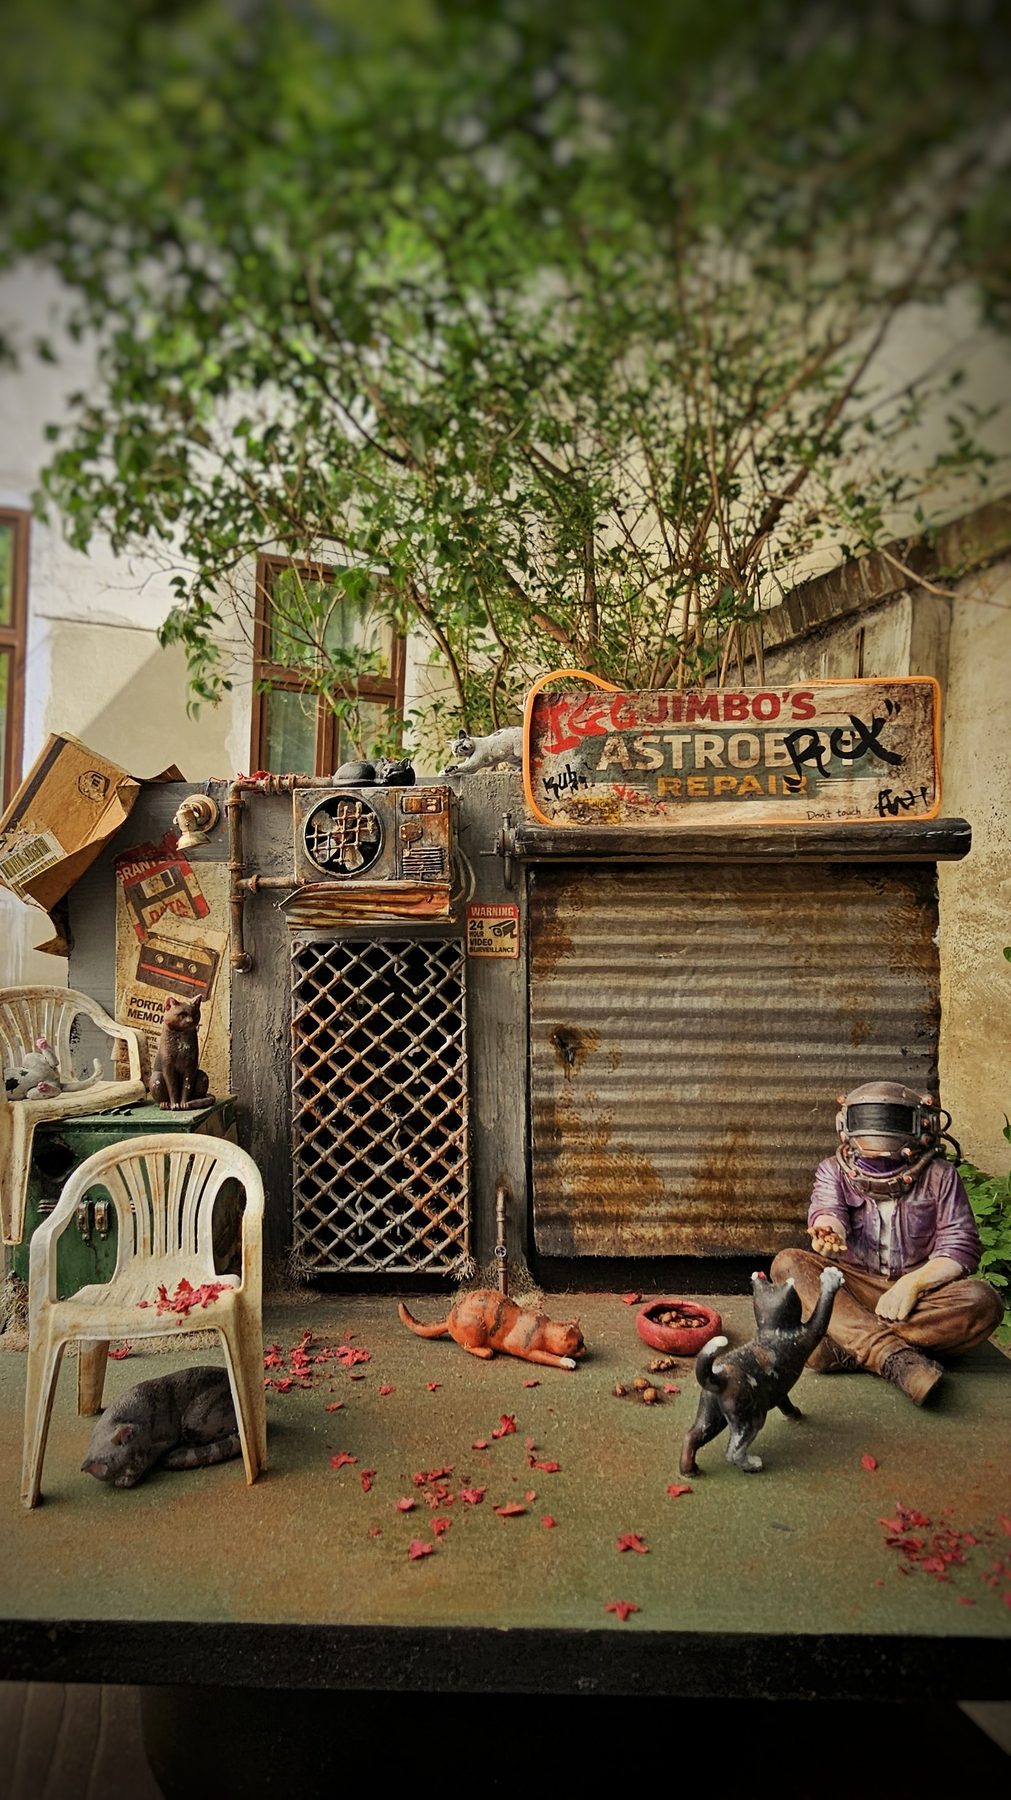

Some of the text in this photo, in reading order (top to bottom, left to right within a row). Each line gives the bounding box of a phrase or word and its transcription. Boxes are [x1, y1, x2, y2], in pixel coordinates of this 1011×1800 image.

[644, 692, 817, 724] JIMBO'S
[657, 774, 807, 797] REPAIR
[806, 806, 861, 821] Don't touch
[471, 906, 514, 917] WARNING
[469, 920, 484, 930] 24
[129, 997, 166, 1013] PORTA
